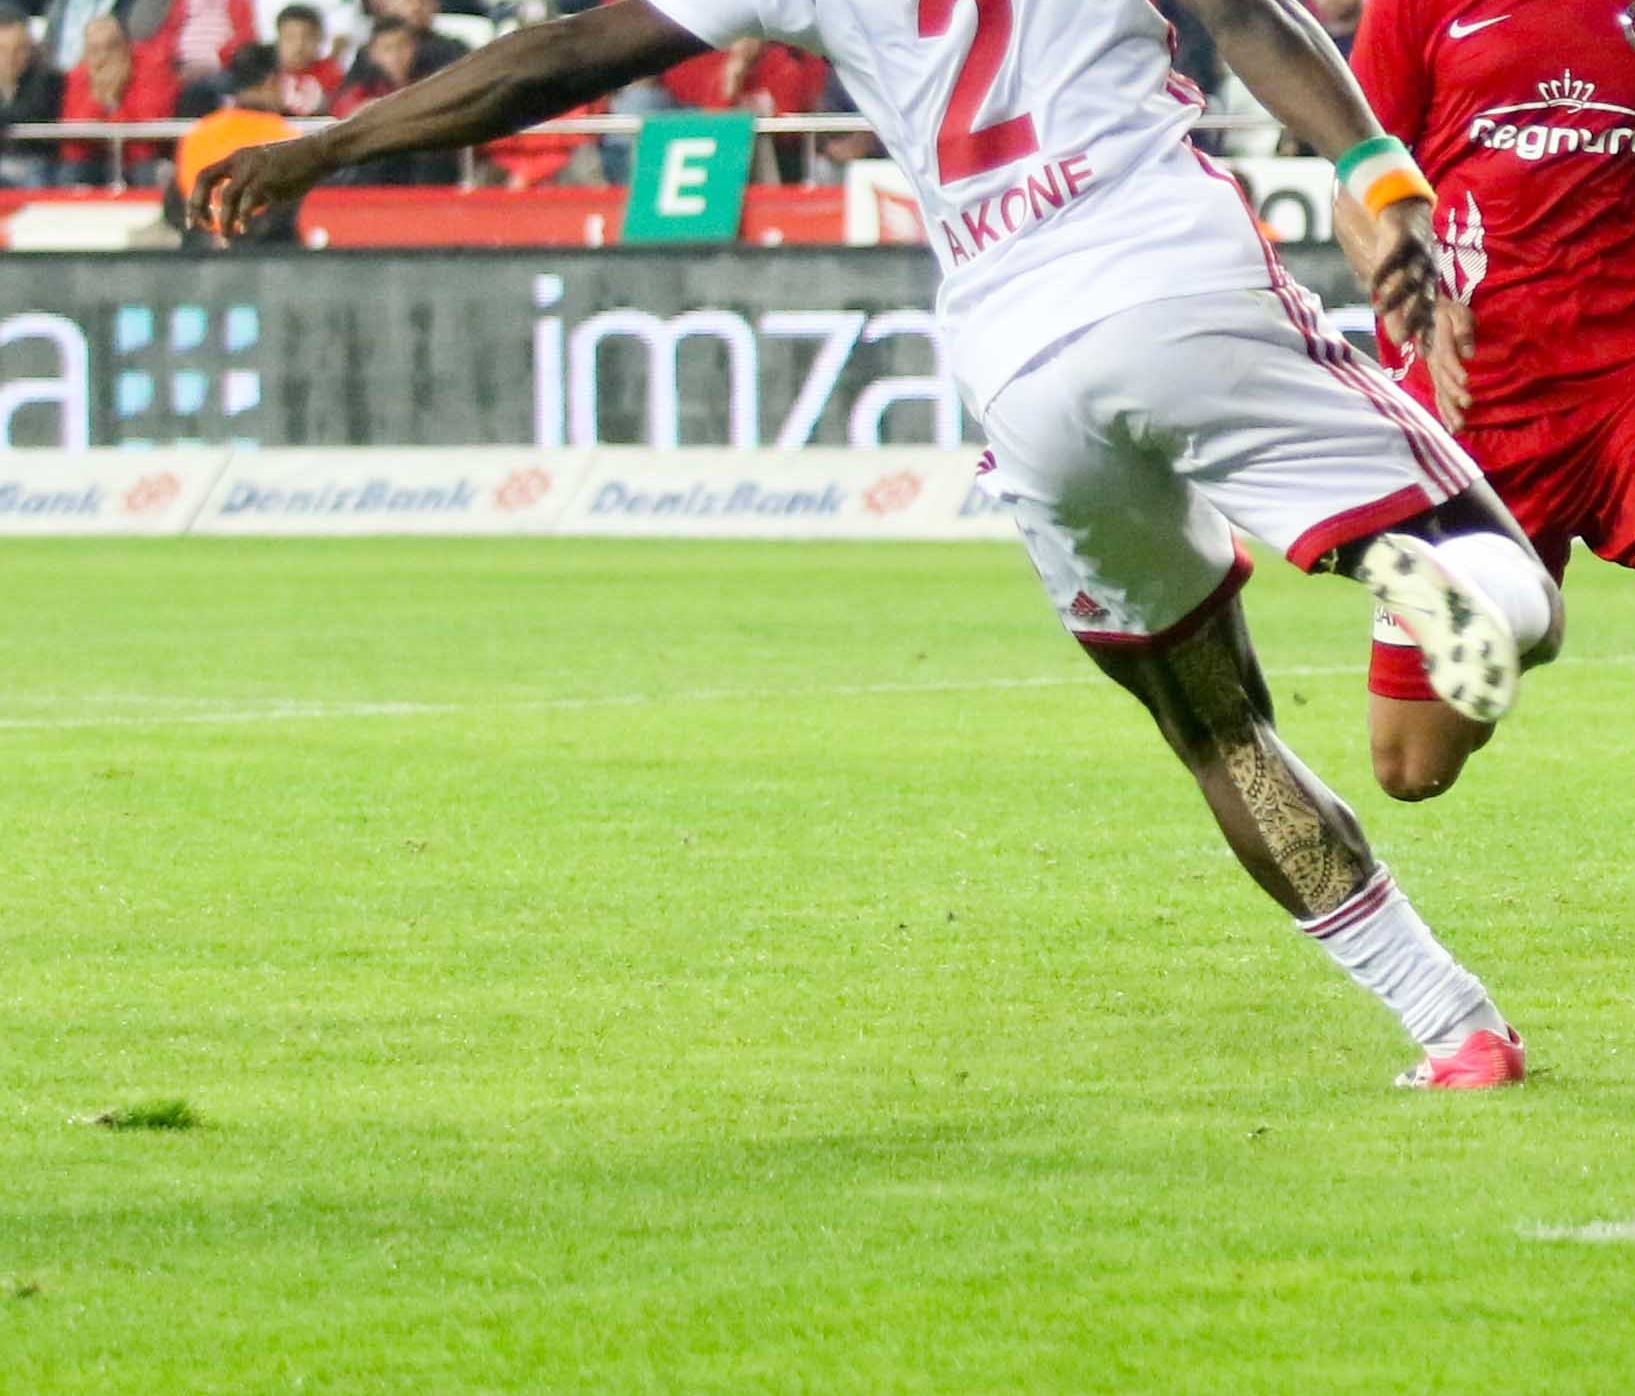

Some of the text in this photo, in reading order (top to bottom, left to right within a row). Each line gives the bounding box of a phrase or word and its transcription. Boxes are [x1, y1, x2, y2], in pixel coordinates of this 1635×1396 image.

[657, 137, 718, 216] E
[941, 153, 1095, 266] A.KONE
[534, 273, 964, 450] imza
[589, 480, 850, 518] DenizBank
